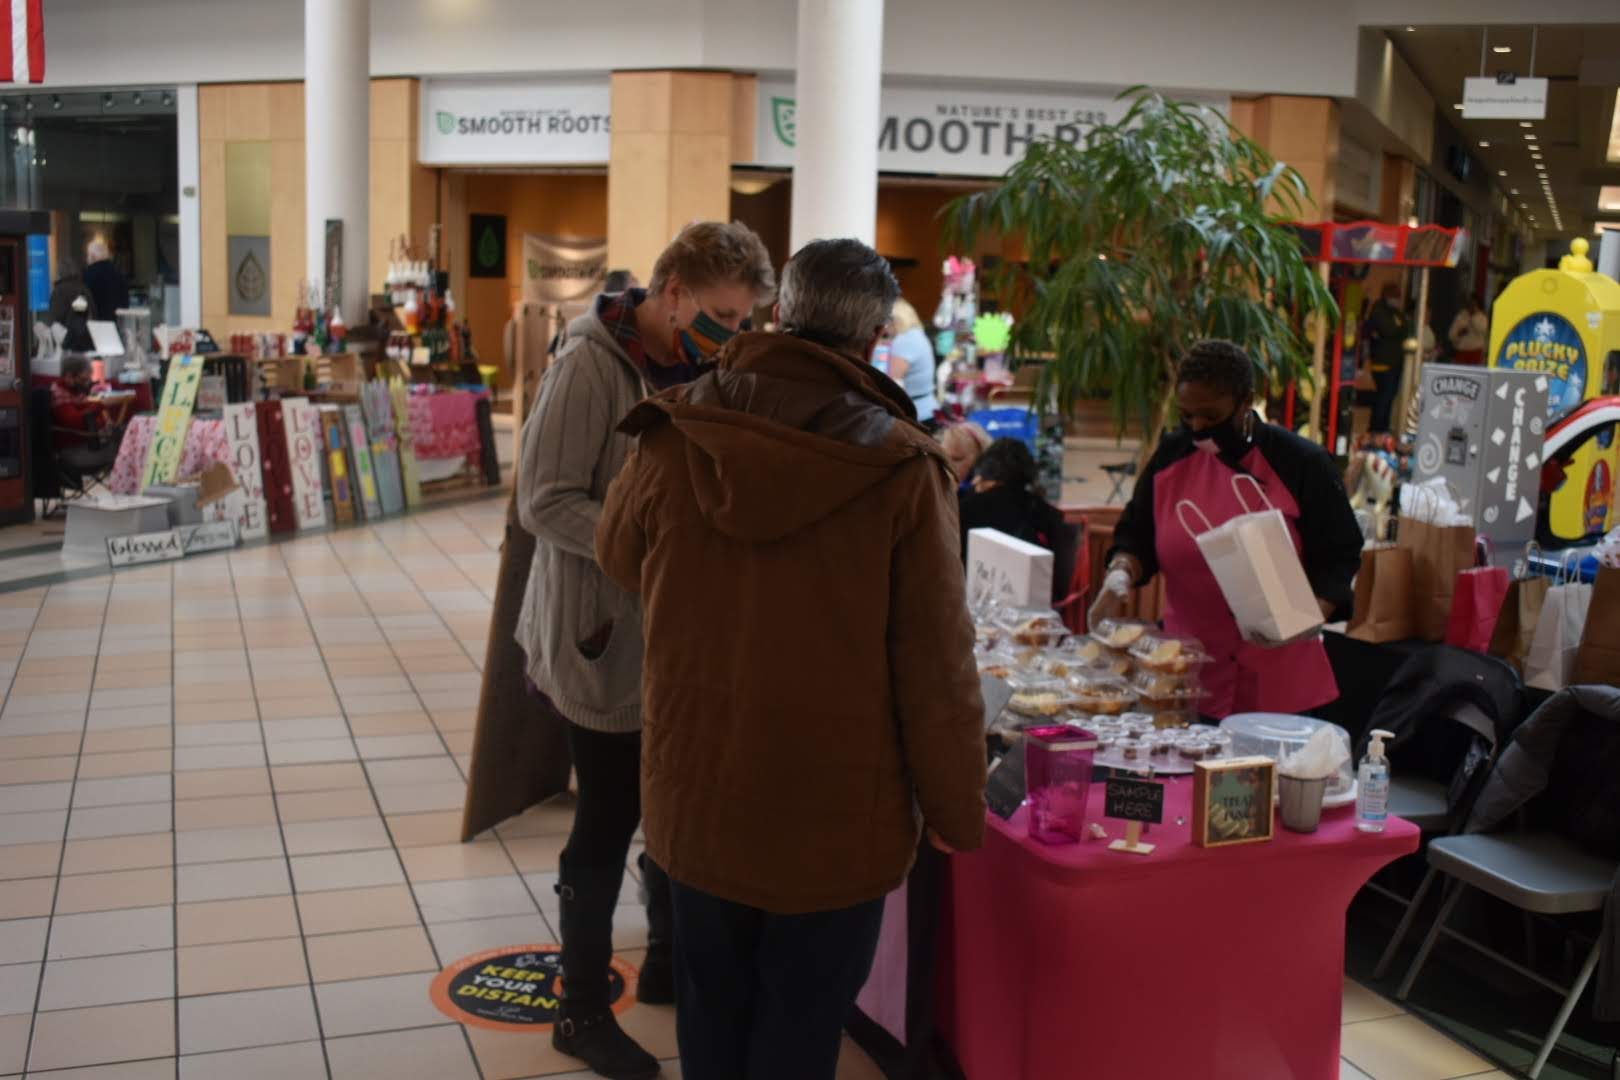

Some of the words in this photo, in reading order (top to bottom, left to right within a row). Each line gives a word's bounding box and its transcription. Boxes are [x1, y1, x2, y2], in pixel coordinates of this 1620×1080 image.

[935, 104, 1019, 120] NATURE'S
[1025, 108, 1067, 121] BEST
[458, 117, 541, 135] SMOOTH
[1505, 339, 1580, 365] PLUCKY
[1432, 376, 1479, 400] CHANGE
[1505, 387, 1526, 502] CHANGE
[233, 413, 261, 529] LOVE
[293, 406, 322, 519] LOVE
[1113, 800, 1153, 817] HERE
[473, 974, 538, 994] YOUR
[481, 965, 545, 981] KEEP
[456, 984, 560, 1010] DISTAN
